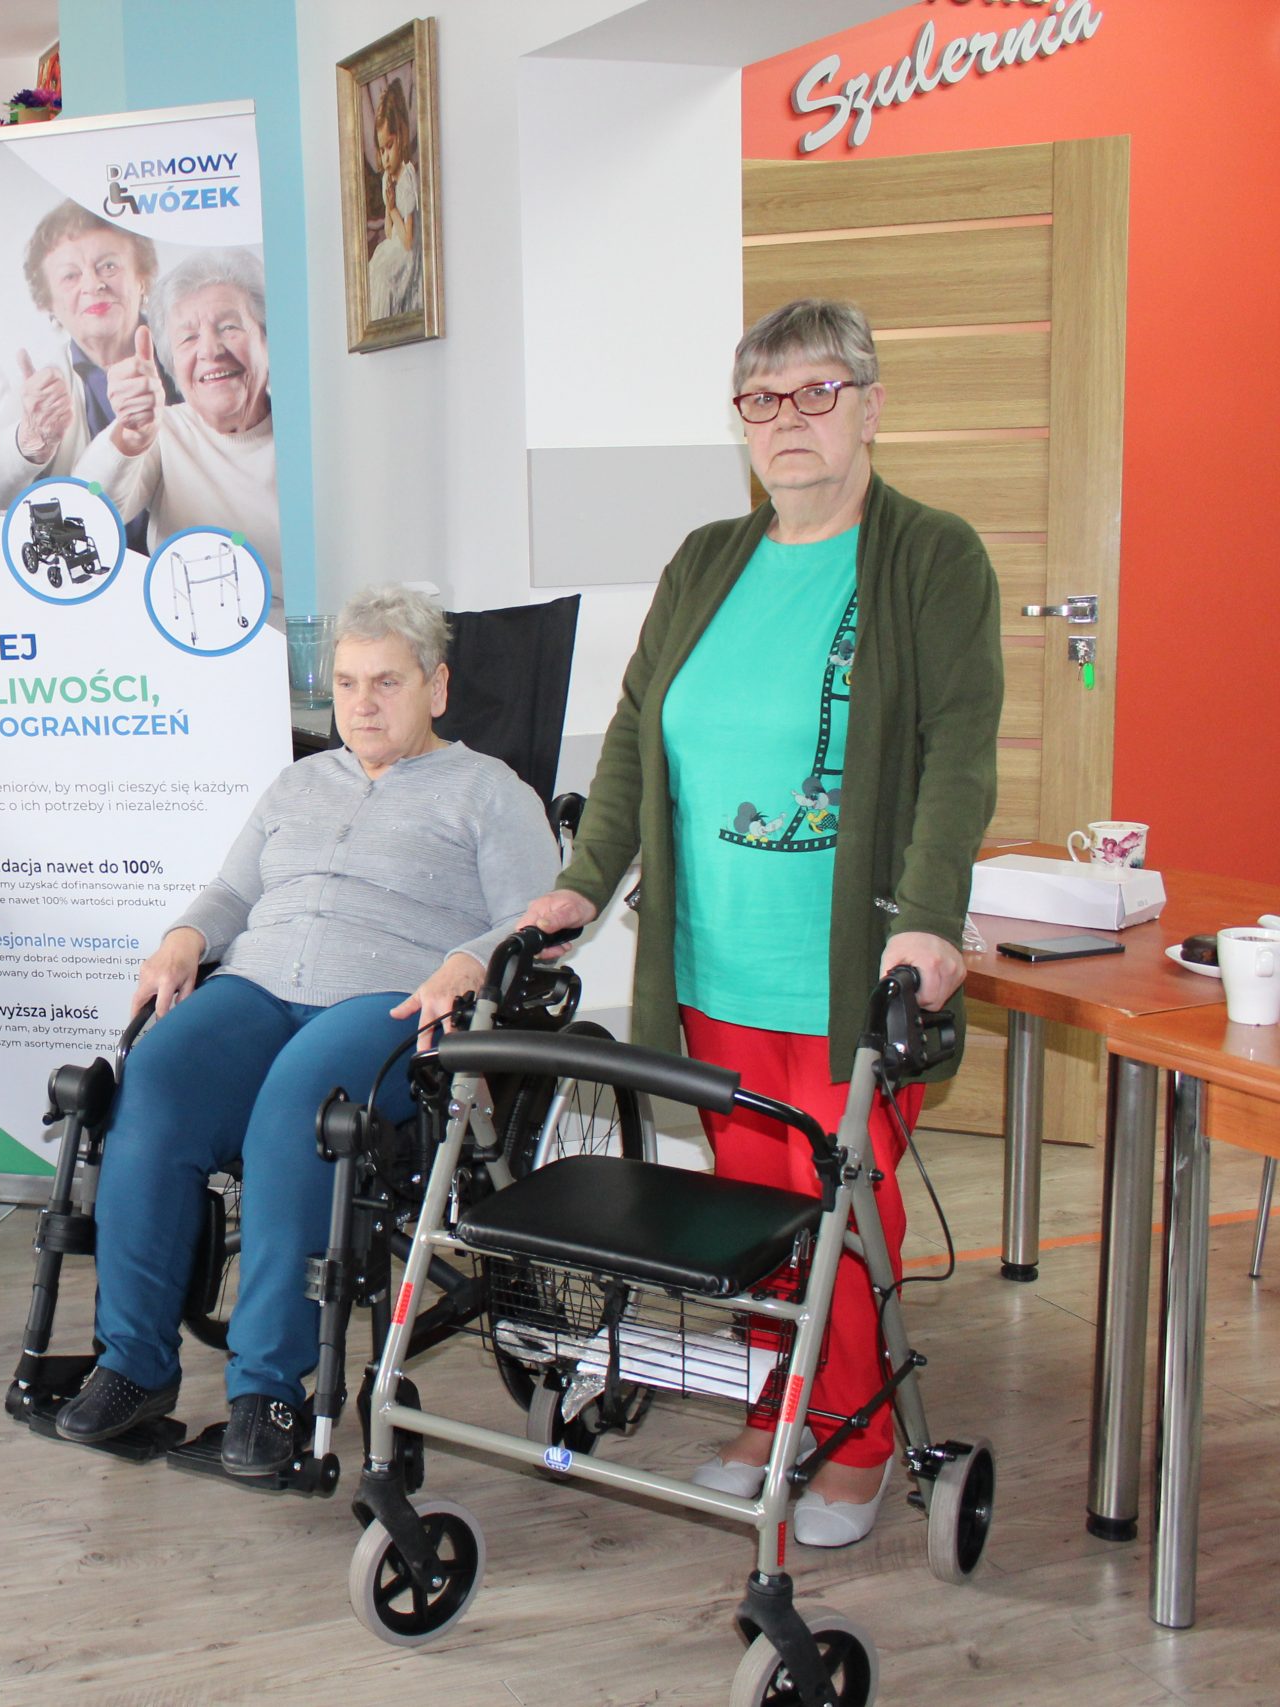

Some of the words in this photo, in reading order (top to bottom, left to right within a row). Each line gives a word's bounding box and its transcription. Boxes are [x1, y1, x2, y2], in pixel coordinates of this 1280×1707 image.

[792, 0, 1103, 153] Szulernia
[106, 153, 238, 182] DARMOWY
[136, 186, 240, 215] WÓZEK
[54, 781, 71, 795] by
[74, 780, 114, 795] mogli
[118, 780, 167, 795] cieszyć
[171, 780, 190, 795] się
[194, 780, 249, 795] każdym
[9, 802, 17, 812] o
[21, 800, 40, 812] ich
[45, 800, 105, 814] potrzeby
[116, 799, 207, 812] niezależność.
[46, 861, 95, 874] nawet
[99, 859, 119, 874] do
[122, 860, 164, 875] 100%
[18, 880, 59, 891] uzyskać
[61, 880, 145, 890] dofinansowanie
[147, 883, 161, 891] na
[163, 883, 197, 892] sprzęt
[8, 896, 40, 905] nawet
[42, 896, 69, 905] 100%
[71, 896, 115, 906] wartości
[117, 897, 167, 907] produktu
[70, 934, 140, 951] wsparcie
[23, 953, 59, 963] dobrać
[61, 955, 122, 965] odpowiedni
[125, 958, 146, 966] spr
[31, 969, 45, 978] do
[47, 969, 83, 979] Twoich
[85, 971, 126, 981] potrzeb
[50, 1004, 99, 1021] jakość
[5, 1025, 30, 1033] nam,
[32, 1024, 51, 1035] aby
[53, 1025, 107, 1037] otrzymany
[24, 1040, 93, 1050] asortymencie
